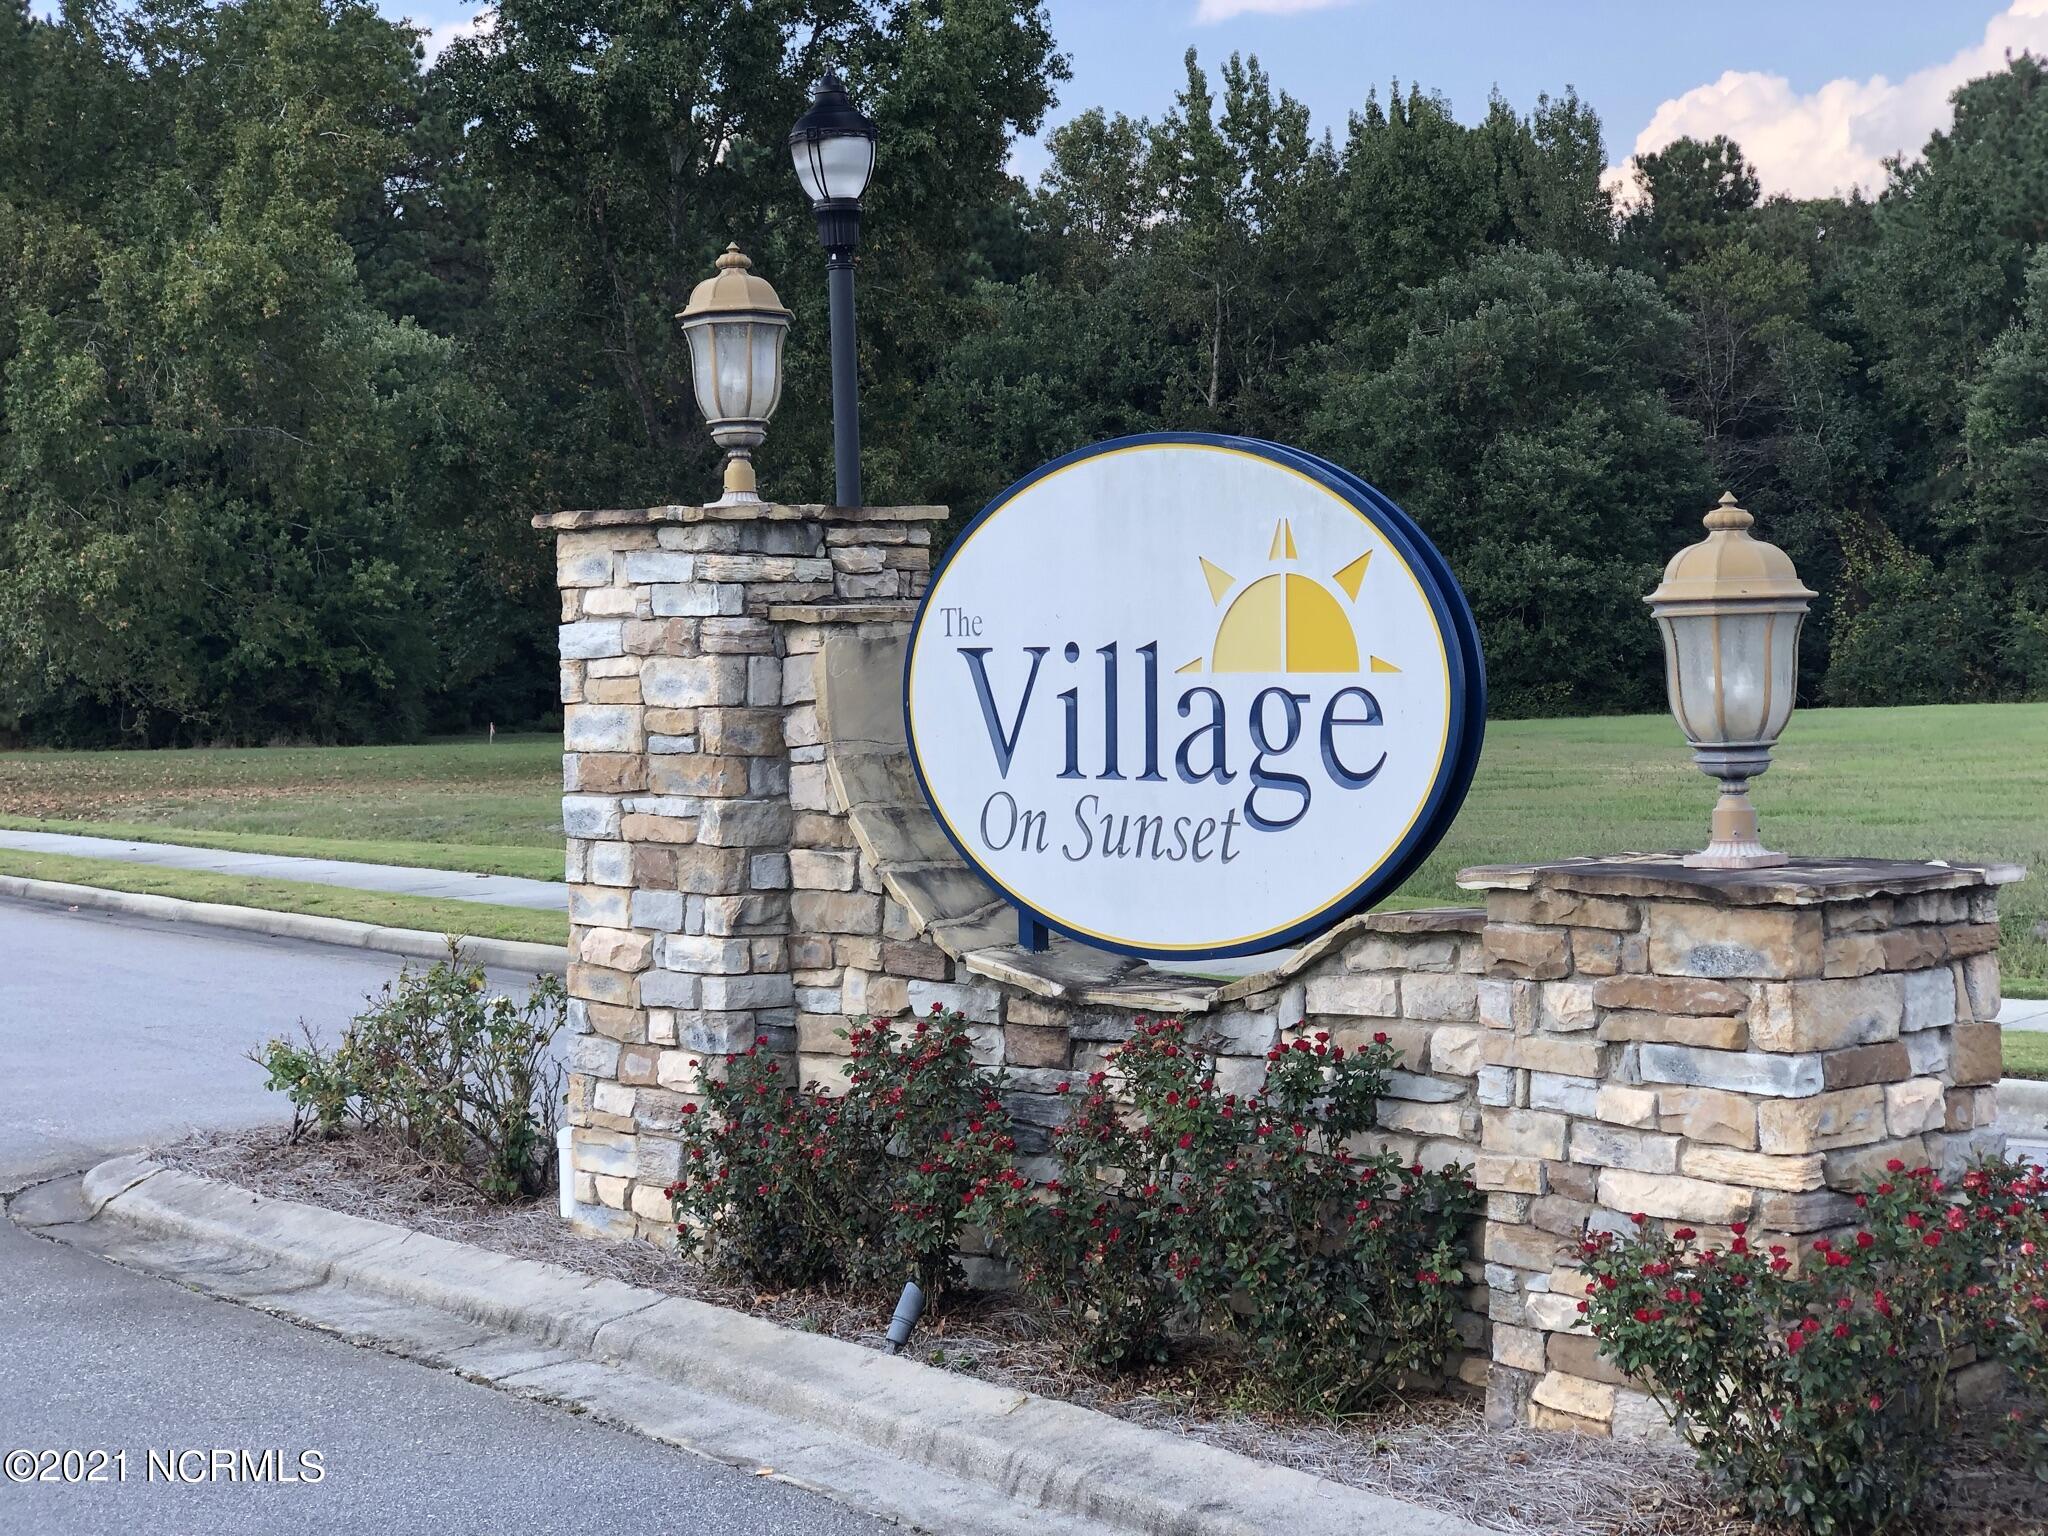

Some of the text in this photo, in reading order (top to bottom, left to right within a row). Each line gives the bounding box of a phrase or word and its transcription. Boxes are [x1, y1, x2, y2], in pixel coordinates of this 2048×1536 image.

[940, 607, 983, 637] The
[957, 640, 1388, 833] Village
[980, 791, 1242, 864] On Sunset
